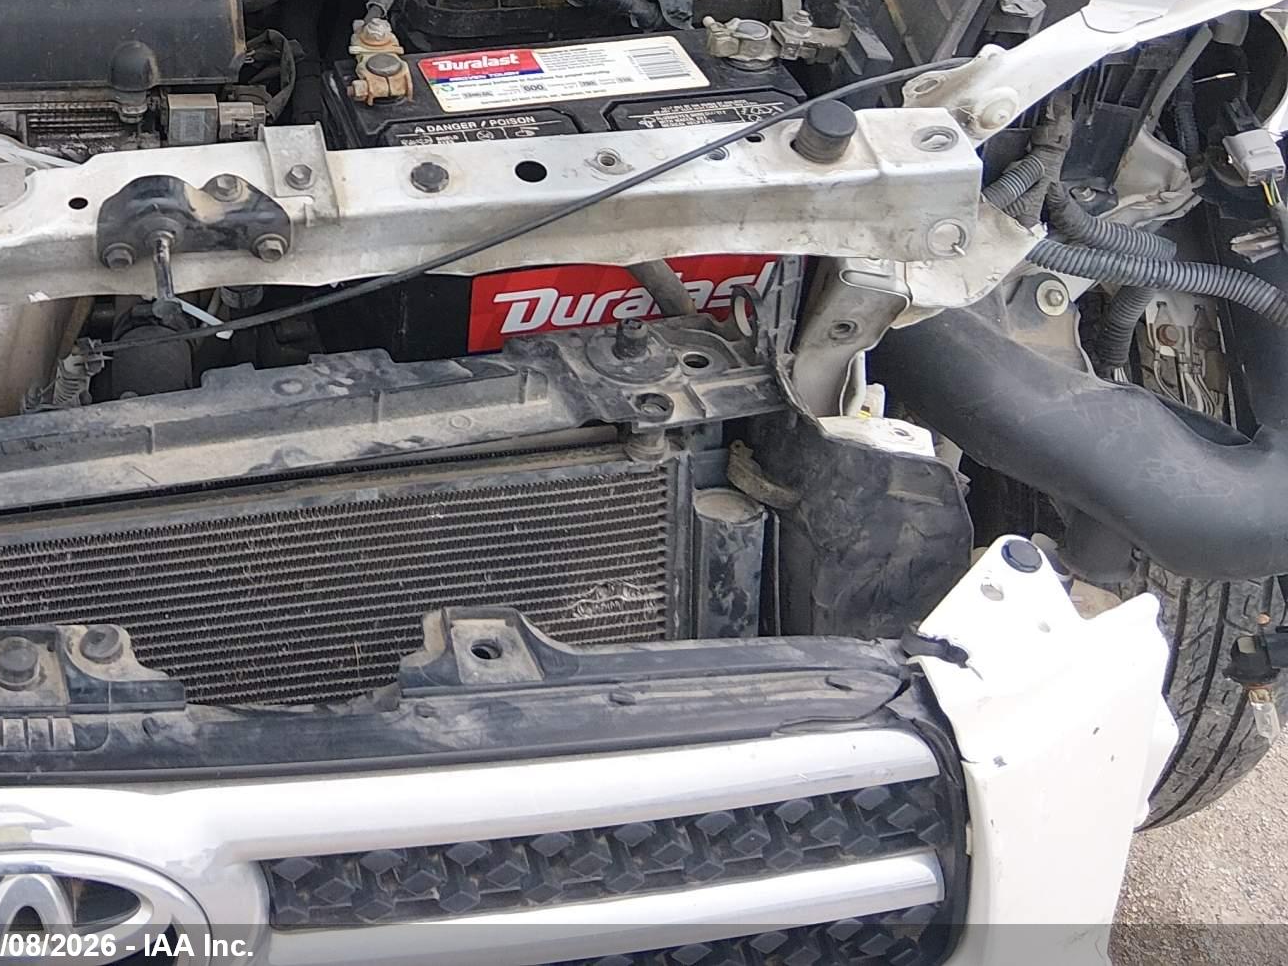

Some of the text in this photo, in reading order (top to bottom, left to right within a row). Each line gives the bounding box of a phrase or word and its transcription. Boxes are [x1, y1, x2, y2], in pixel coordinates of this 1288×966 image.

[432, 53, 520, 71] Duralast
[426, 121, 478, 132] DANGER
[489, 116, 536, 127] POISON
